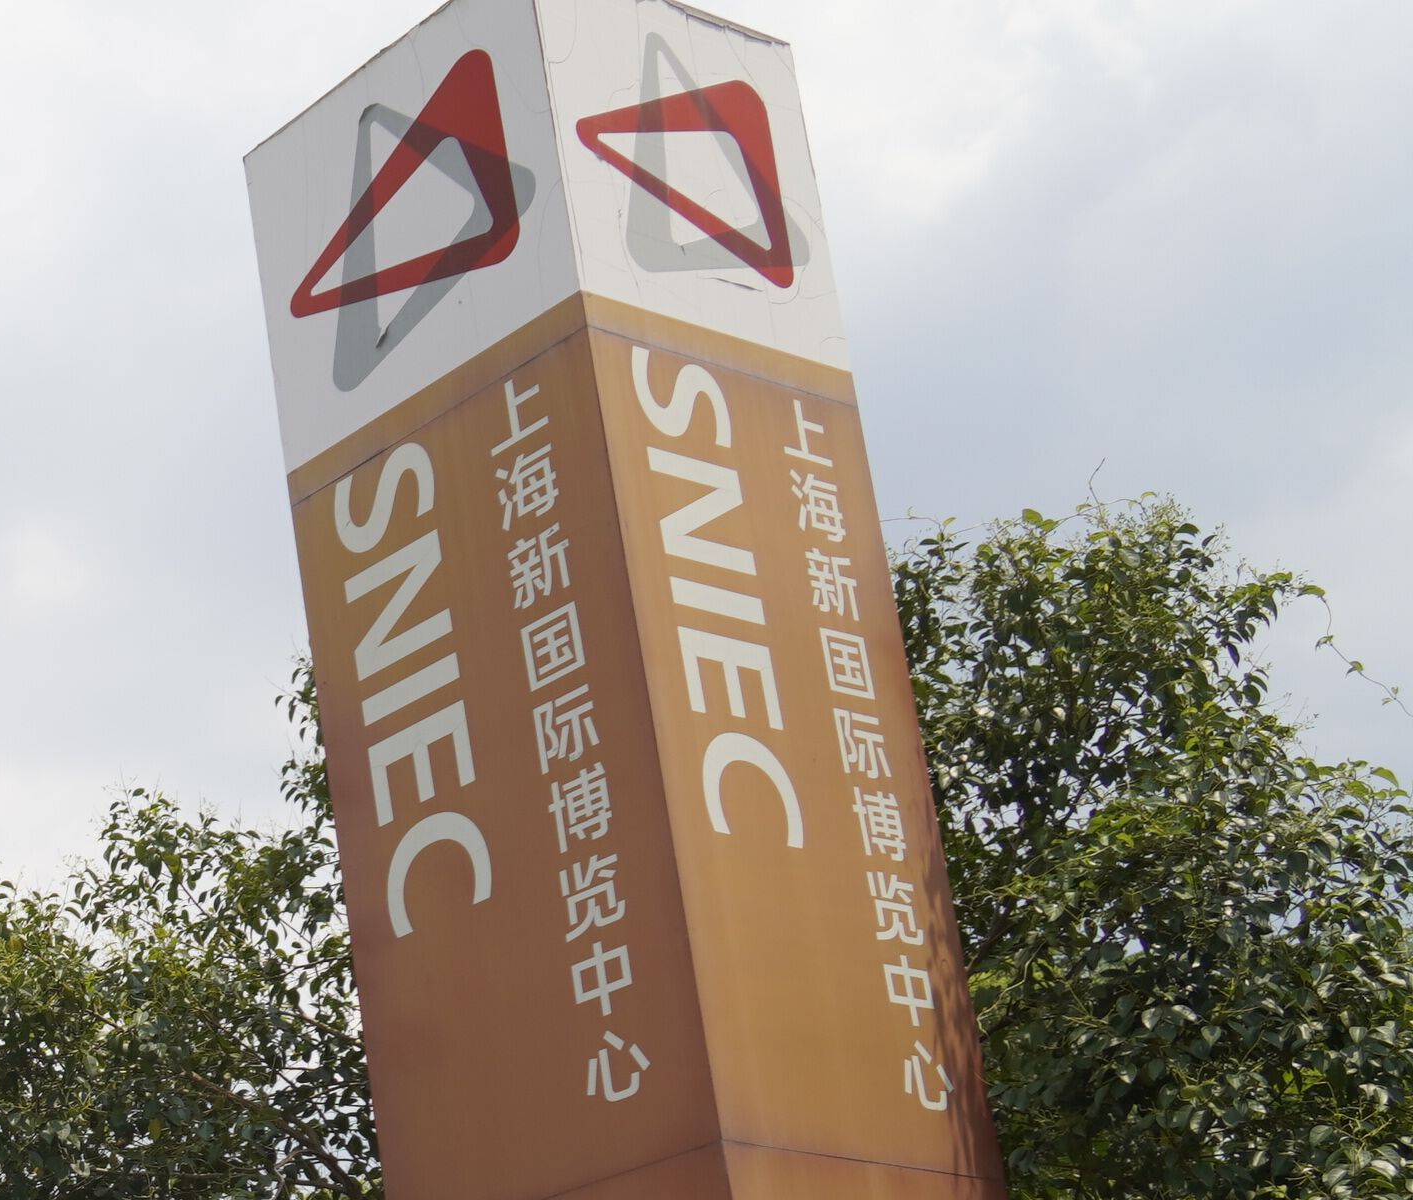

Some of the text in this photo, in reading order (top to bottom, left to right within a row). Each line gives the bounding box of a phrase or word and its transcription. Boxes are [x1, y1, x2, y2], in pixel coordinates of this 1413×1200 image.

[334, 442, 493, 939] SNIEC
[491, 378, 651, 1103] 上海新国际博览中心
[632, 345, 804, 851] SNIEC
[784, 398, 955, 1113] 上海新国际博览中心
